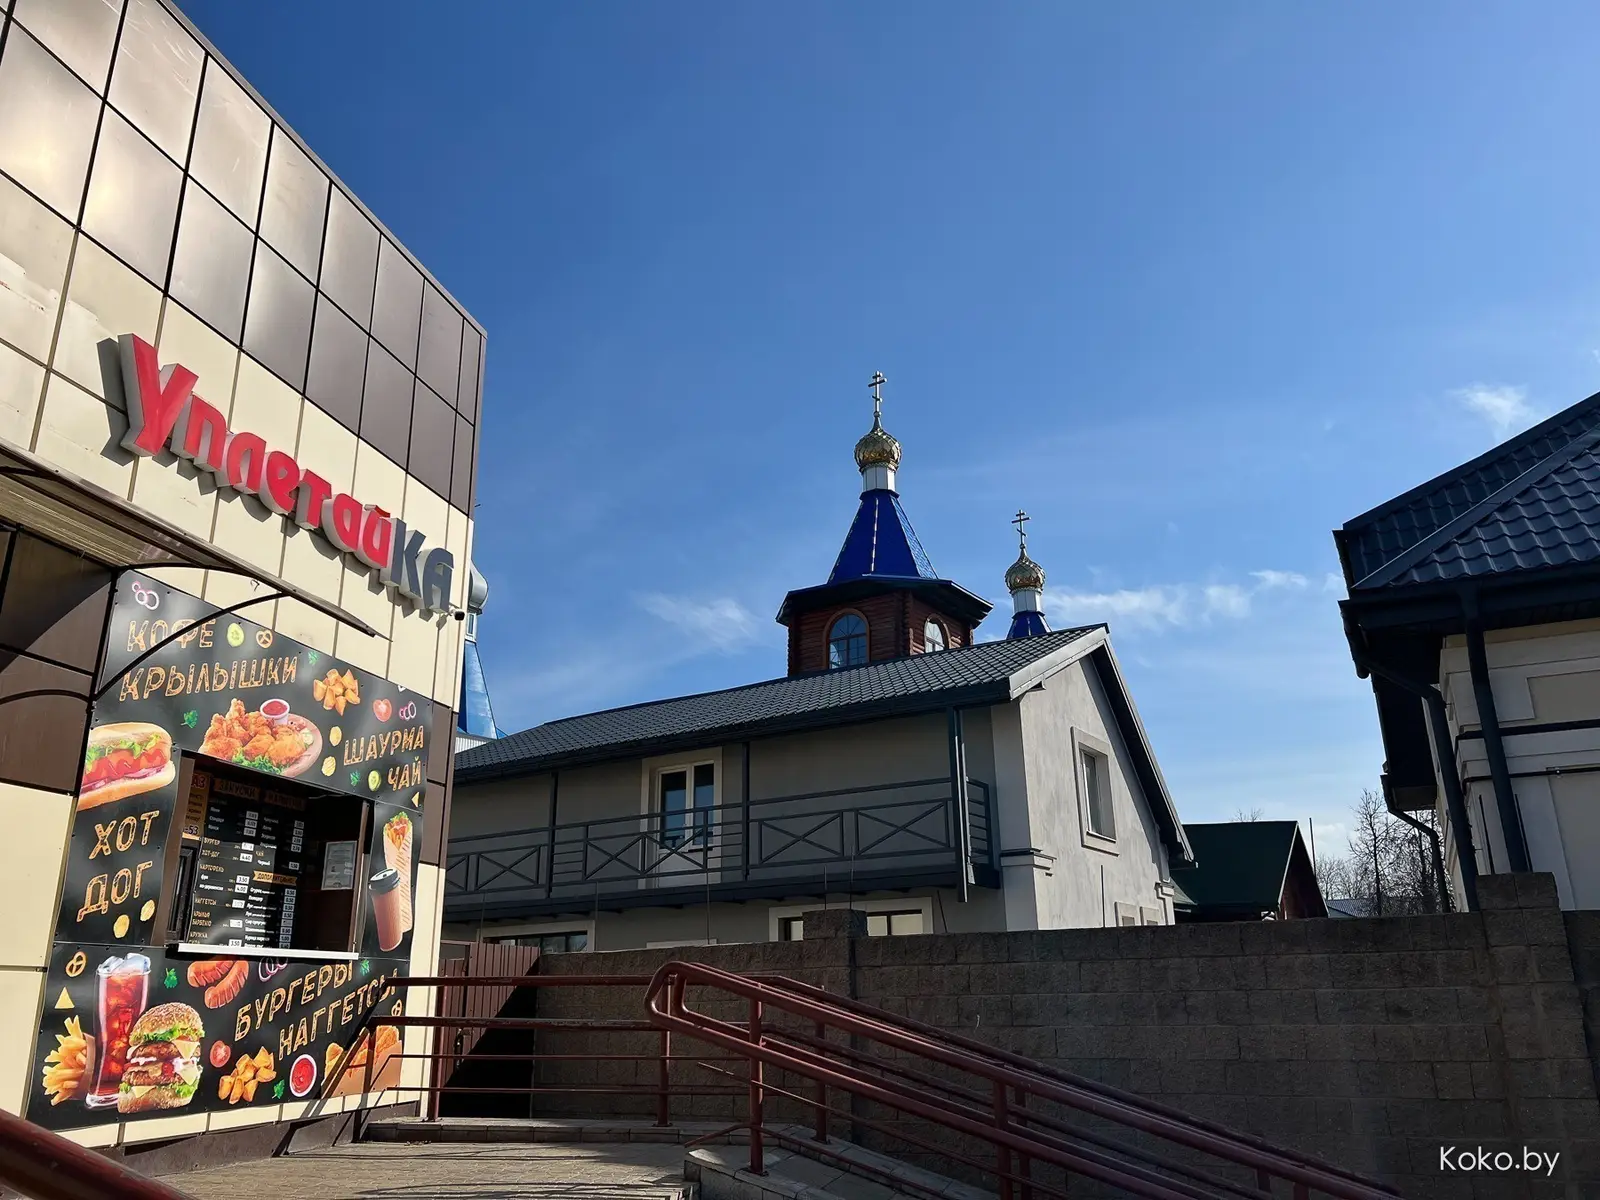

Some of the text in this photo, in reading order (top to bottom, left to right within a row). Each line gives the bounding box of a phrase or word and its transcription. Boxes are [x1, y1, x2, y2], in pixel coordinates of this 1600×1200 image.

[126, 618, 216, 652] КОФЕ
[119, 656, 298, 701] КРЫЛЫШКИ
[343, 725, 424, 766] ШАУРМА
[387, 755, 422, 792] ЧАЙ
[88, 810, 160, 860] ХОТ
[76, 861, 154, 922] ДОГ
[234, 960, 353, 1042] БУРГЕРЫ
